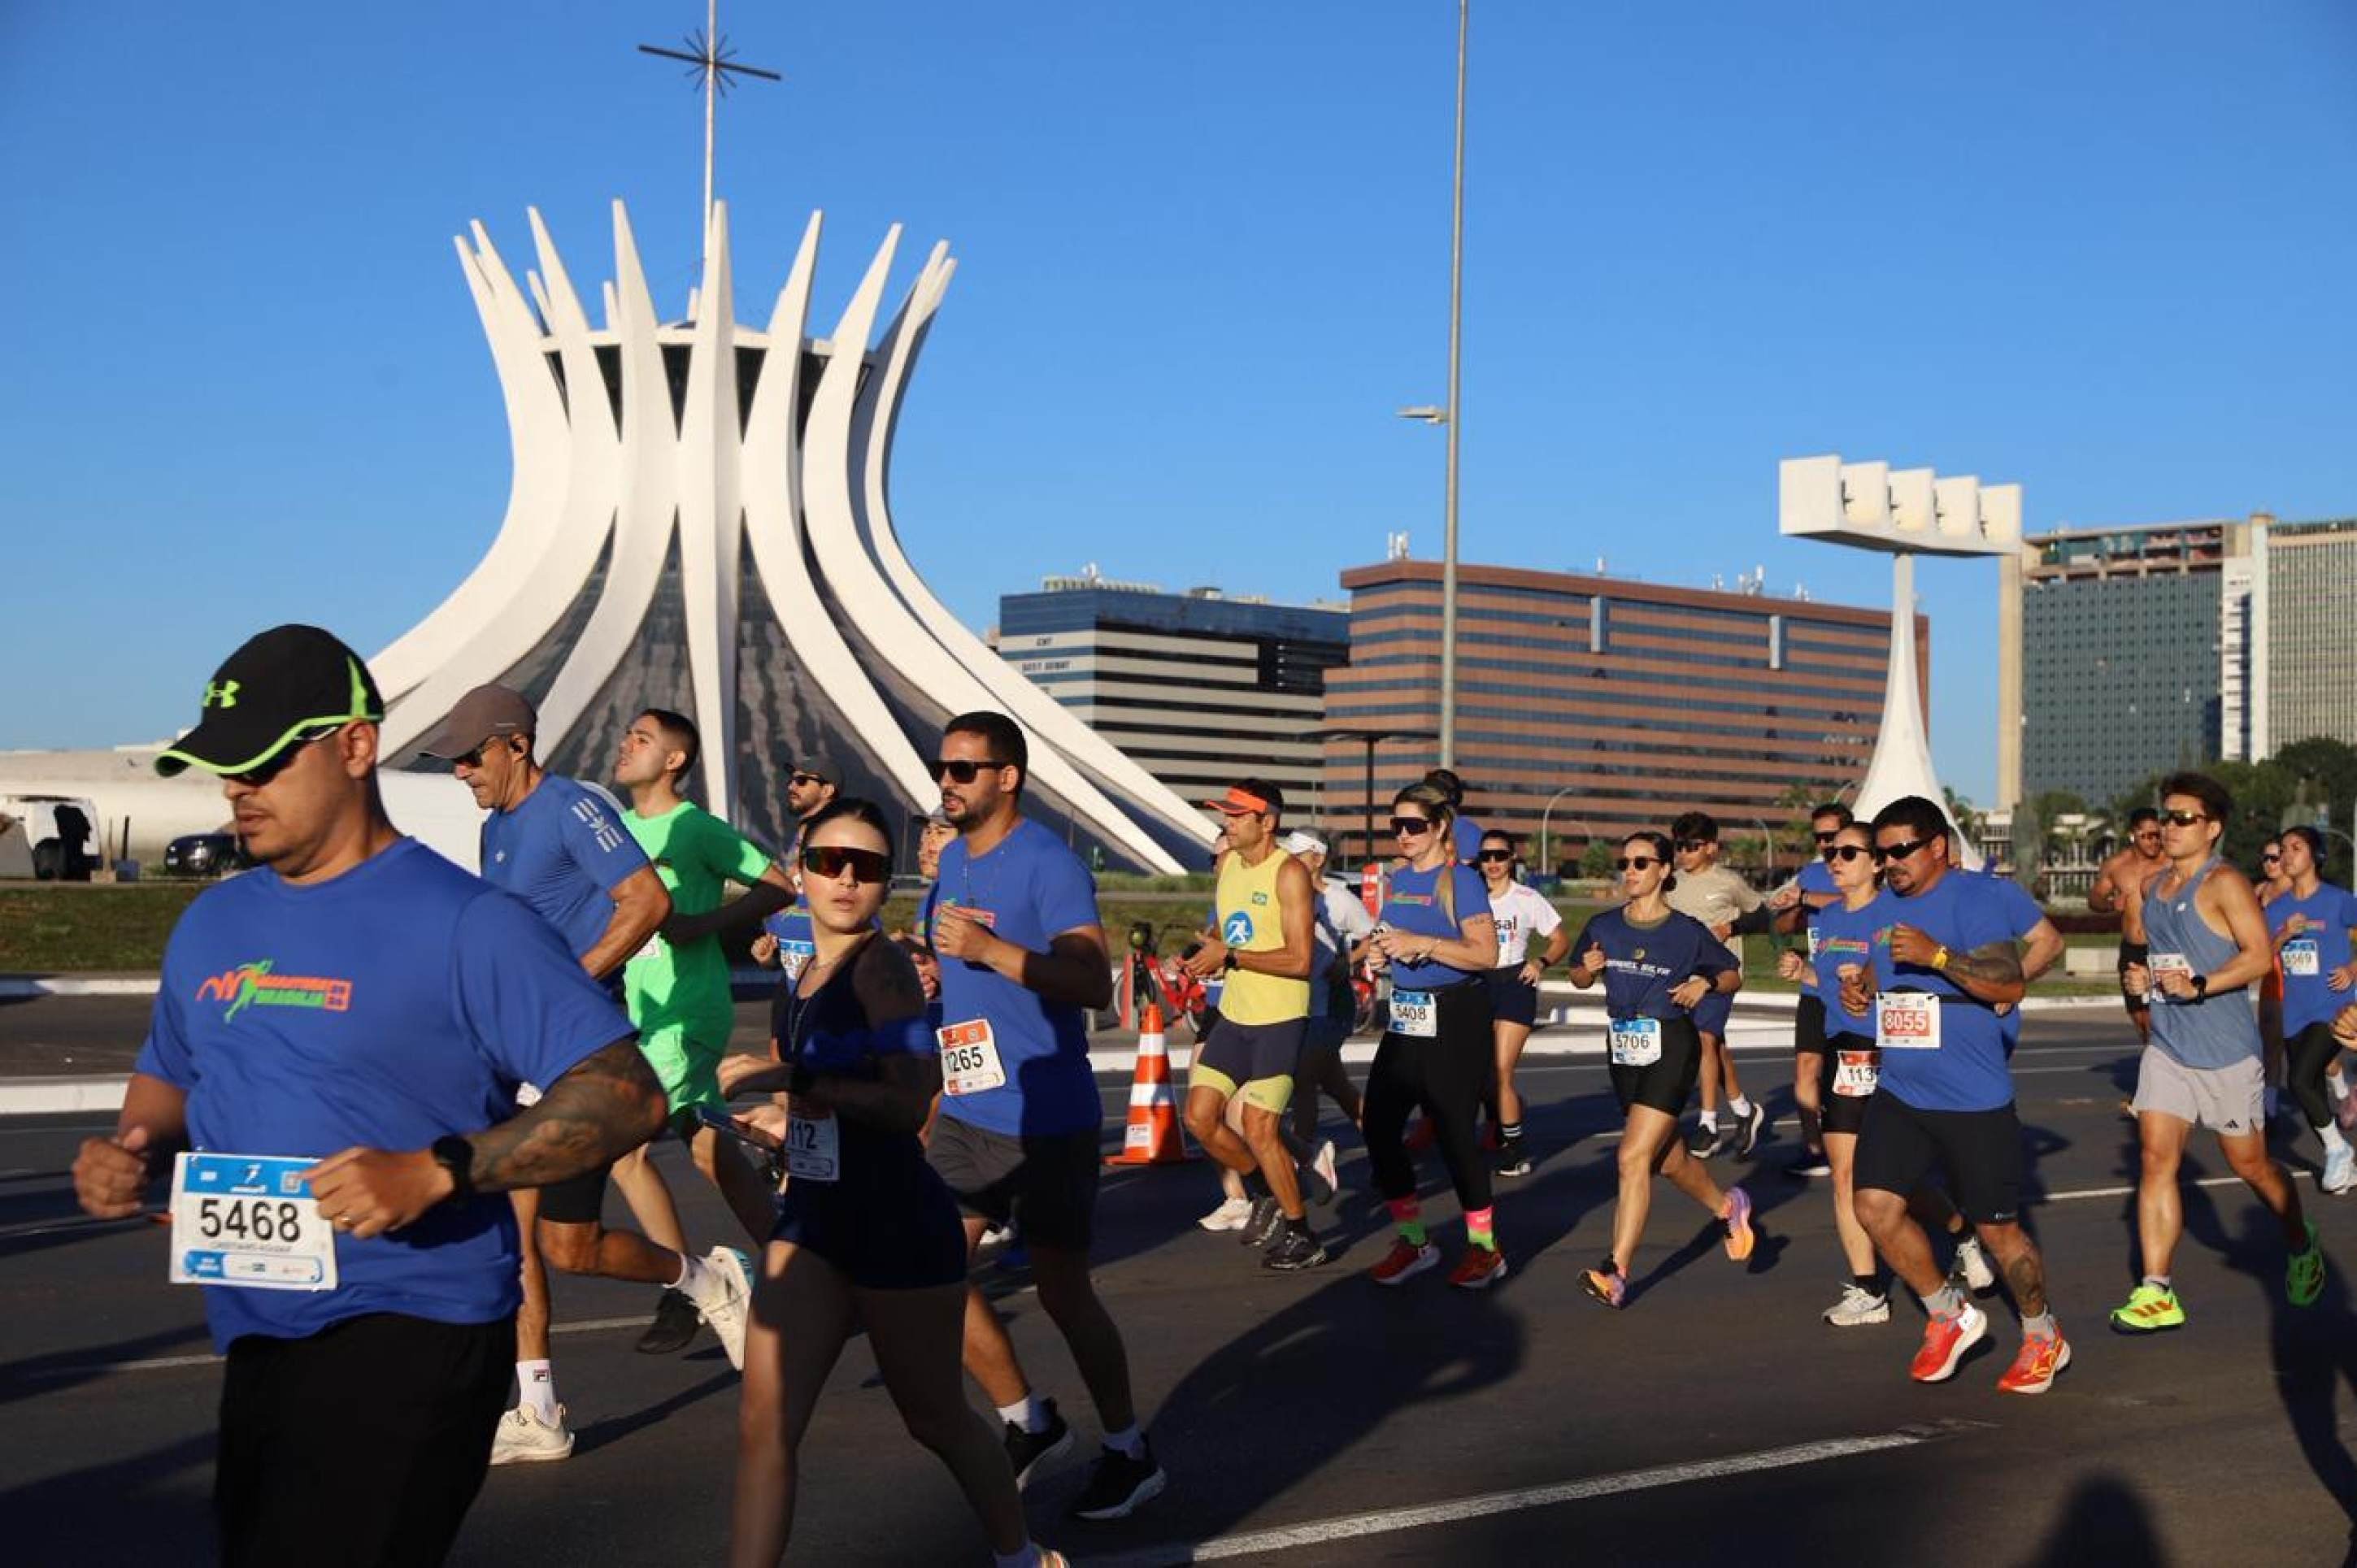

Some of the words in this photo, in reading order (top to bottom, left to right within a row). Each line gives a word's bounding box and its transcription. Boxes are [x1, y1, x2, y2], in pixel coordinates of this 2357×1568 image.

[1885, 1010, 1927, 1031] 8055
[1616, 1033, 1650, 1049] 5706
[200, 1198, 301, 1243] 5468
